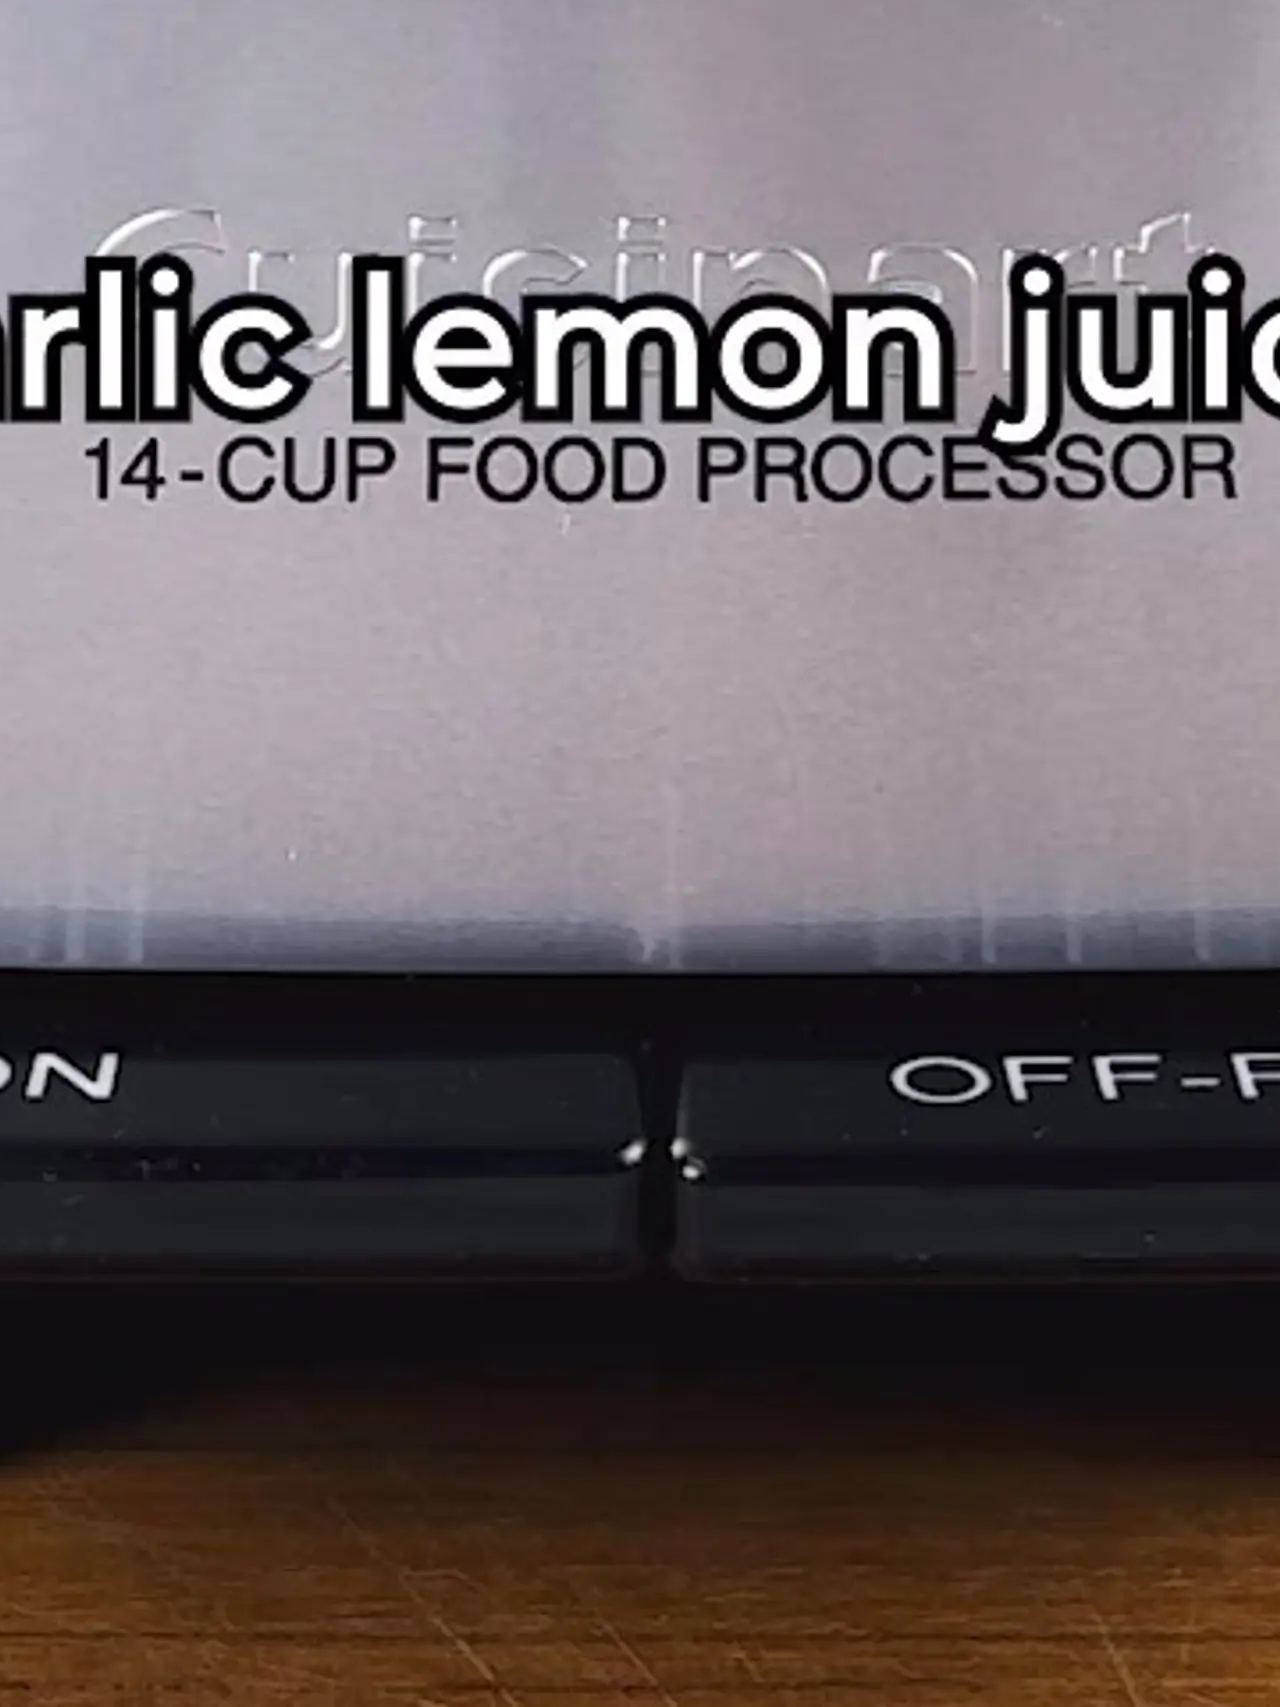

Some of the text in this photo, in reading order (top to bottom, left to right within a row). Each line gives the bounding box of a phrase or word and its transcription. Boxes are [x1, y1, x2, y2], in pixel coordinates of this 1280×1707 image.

[83, 432, 1239, 505] 14-CUP FOOD PROCESSOR
